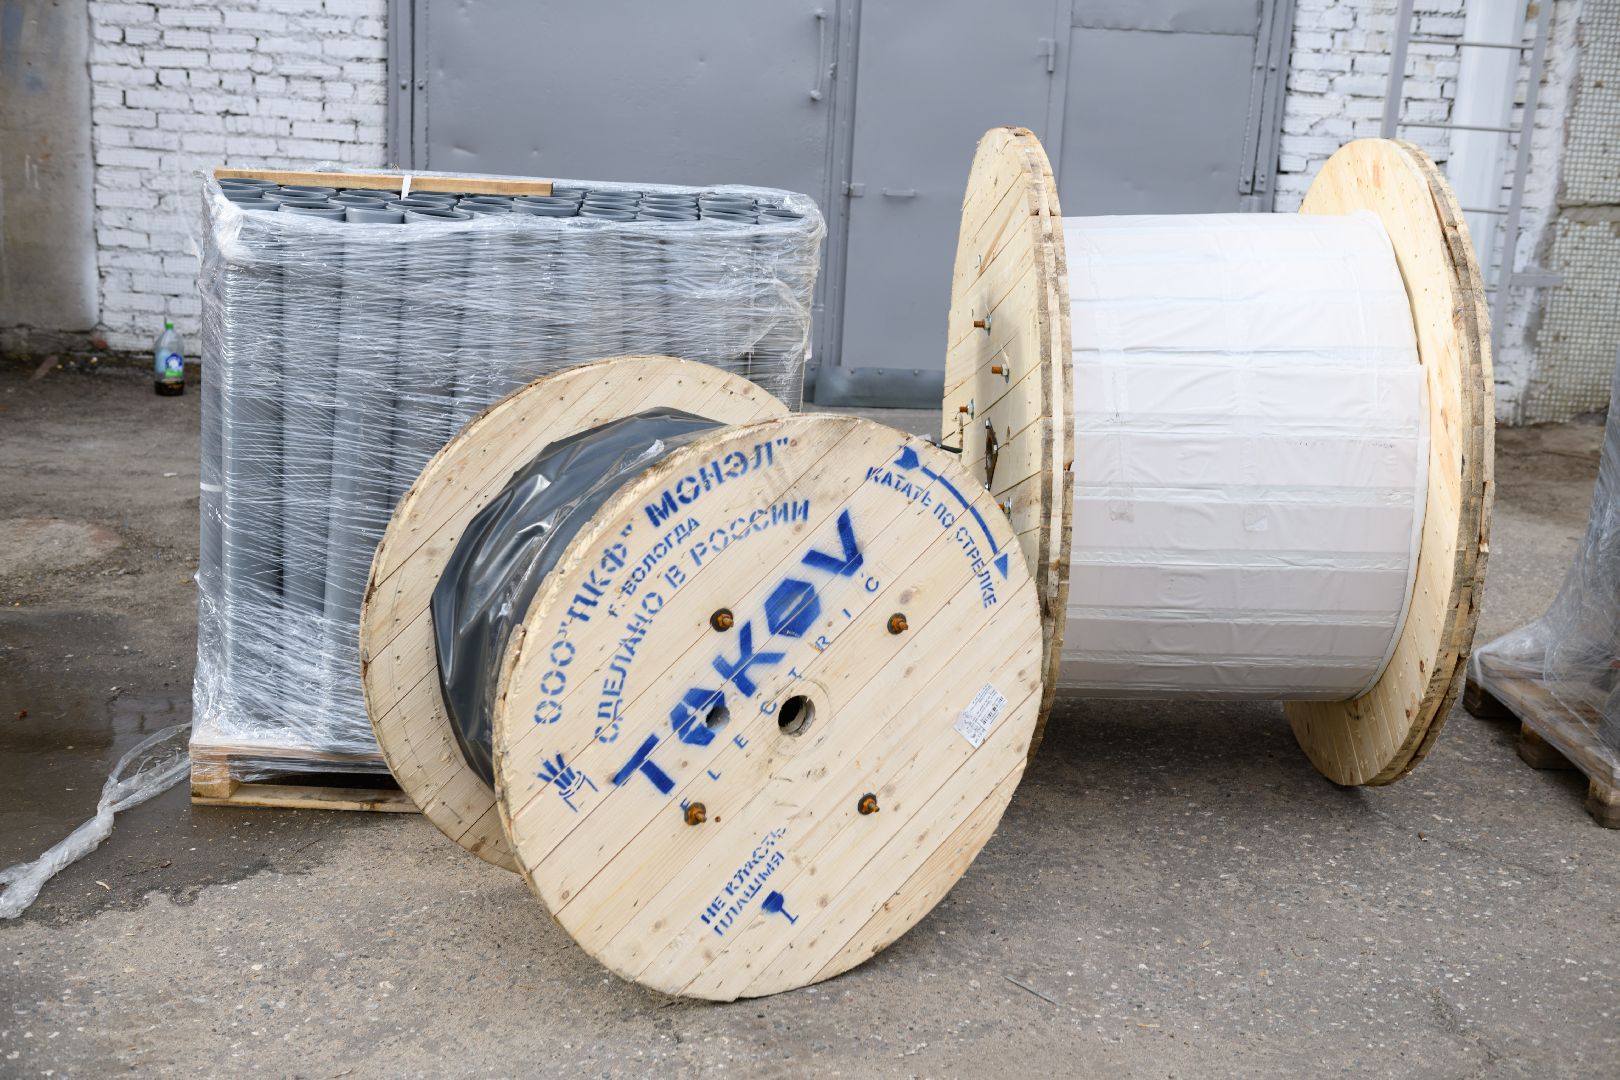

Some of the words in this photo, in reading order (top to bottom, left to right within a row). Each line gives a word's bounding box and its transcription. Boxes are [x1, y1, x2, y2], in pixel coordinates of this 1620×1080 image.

[620, 517, 701, 597] ВОЛОГДА
[864, 466, 932, 507] КАТАТЬ
[933, 502, 955, 528] ПО
[956, 526, 997, 609] СТРЕЛКЕ
[595, 591, 664, 743] СДЕЛАНО
[664, 564, 687, 589] В
[689, 499, 809, 567] РОССИИ
[701, 896, 726, 924] НЕ
[714, 851, 785, 936] ПЛАШМЯ
